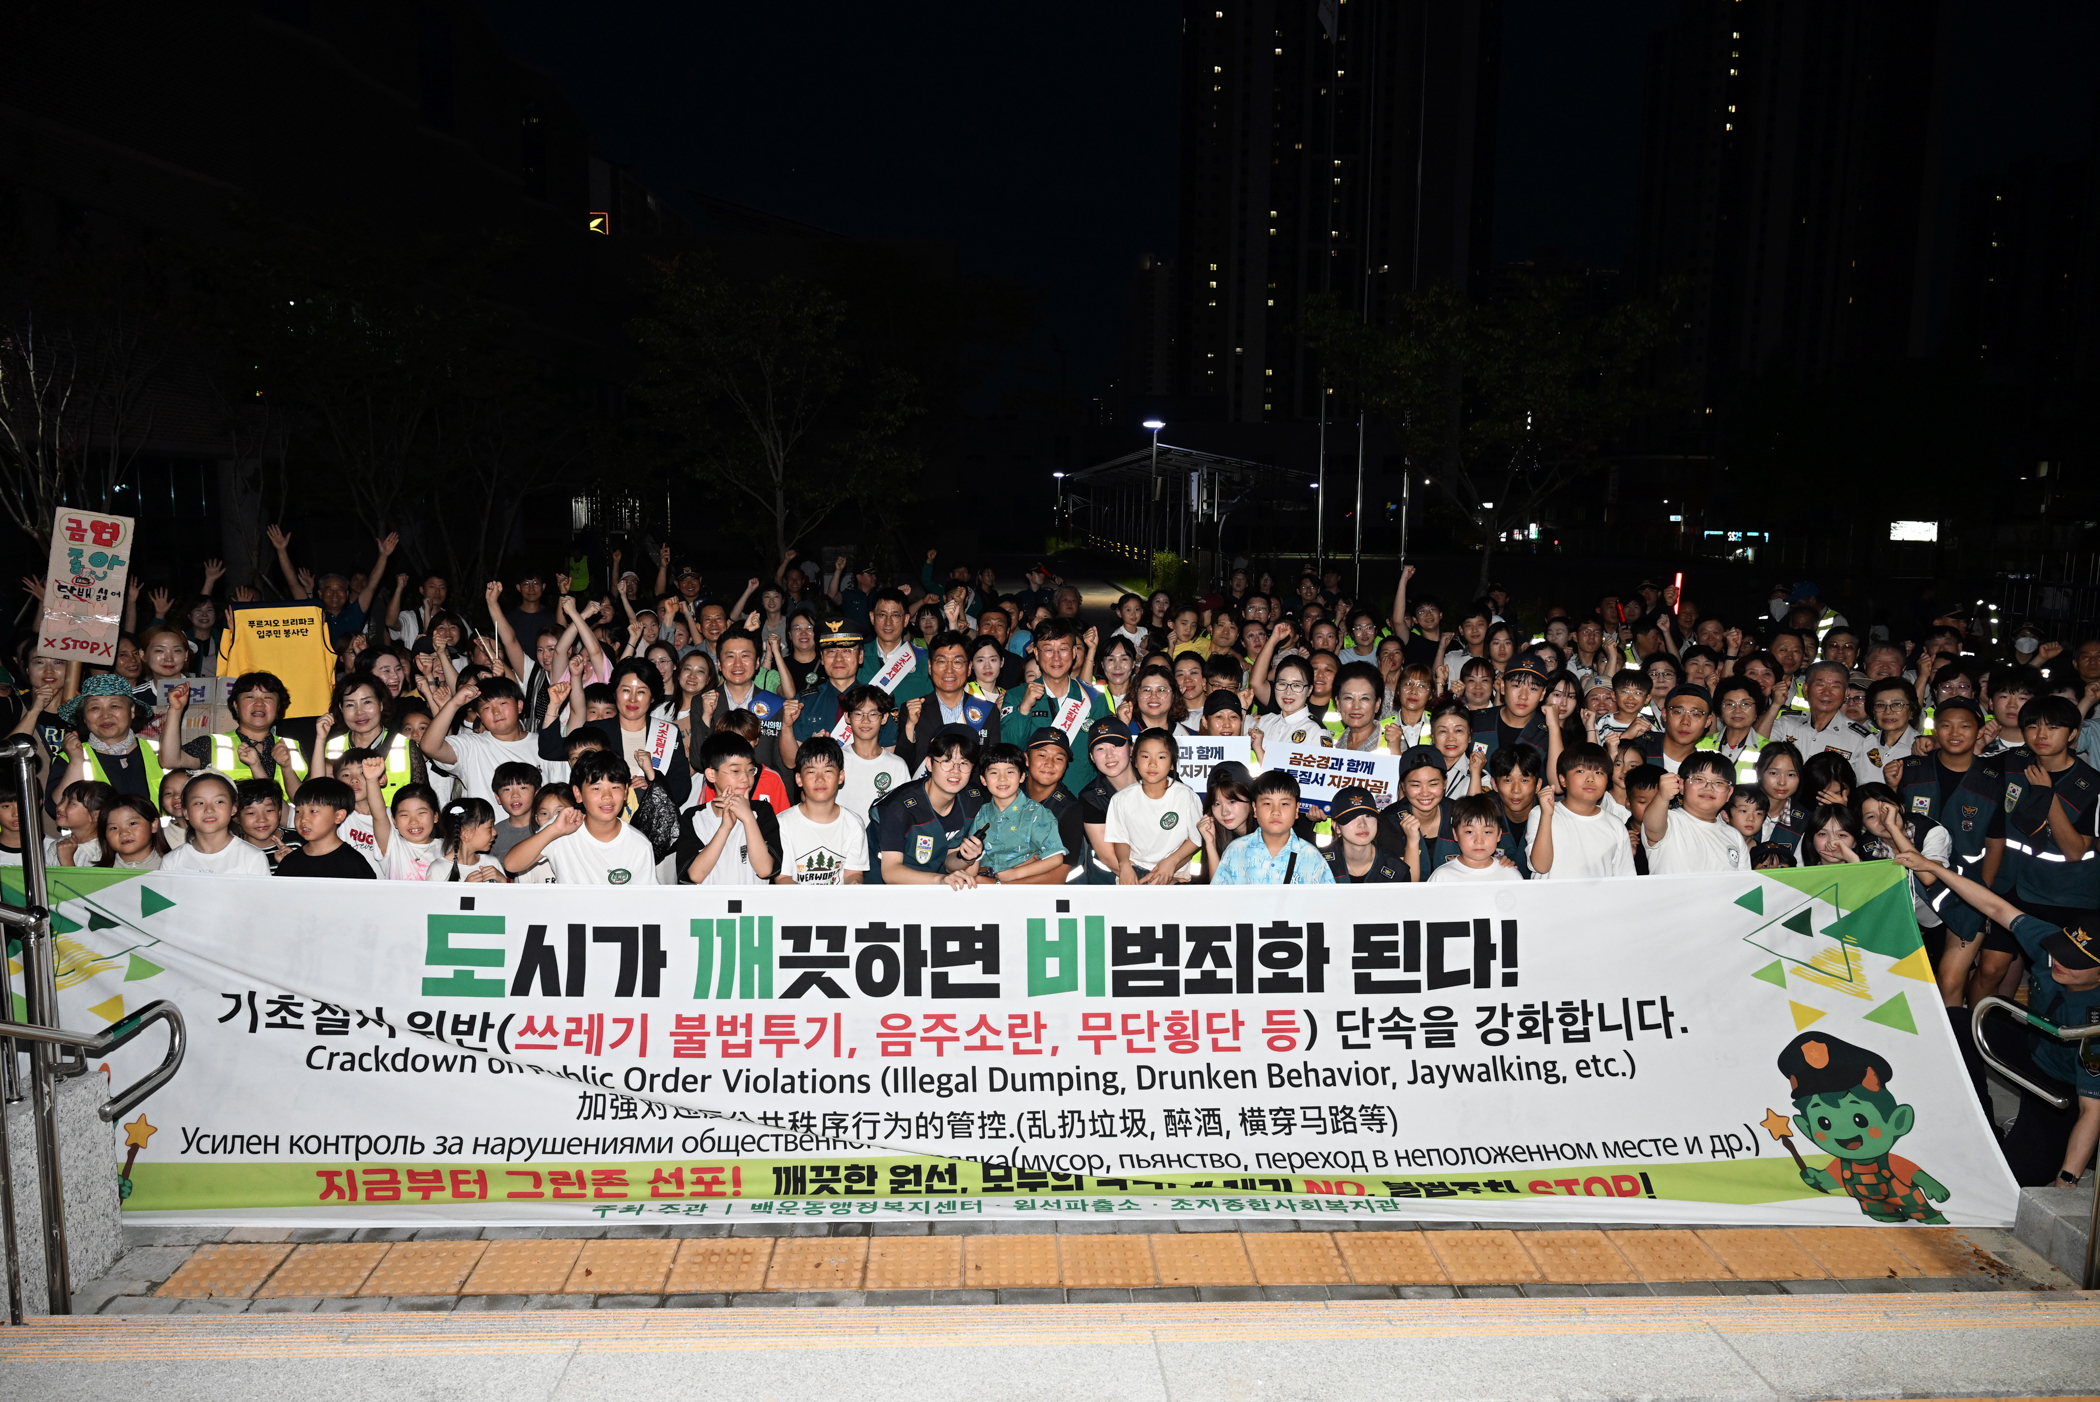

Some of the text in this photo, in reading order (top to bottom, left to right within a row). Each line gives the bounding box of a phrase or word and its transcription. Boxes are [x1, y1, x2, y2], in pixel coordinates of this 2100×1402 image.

[65, 517, 120, 547] 금연
[67, 547, 126, 575] 좋아
[248, 617, 315, 628] 푸르지오 브리파크
[256, 628, 309, 639] 입주민 봉사단
[59, 637, 100, 654] STOP
[1196, 745, 1225, 761] 함께
[1289, 752, 1375, 775] 곰순경과 함께
[422, 897, 1519, 999] 도시가 깨끗하면 비범죄화 된다!
[669, 1012, 858, 1059] 불법투기,
[875, 1012, 1059, 1058] 음주소란,
[1077, 1008, 1245, 1053] 무단횡단
[1261, 1008, 1318, 1052] 등)
[1336, 1005, 1459, 1050] 단속을
[1474, 995, 1689, 1046] 강화합니다.
[306, 1045, 477, 1074] Crackdown
[488, 1057, 524, 1074] on
[623, 1066, 712, 1094] Order
[722, 1066, 871, 1095] Violations
[881, 1064, 977, 1098] (Illegal
[993, 1066, 1126, 1098] Dumping,
[1136, 1062, 1259, 1092] Drunken
[1267, 1057, 1398, 1091] Behavior,
[1406, 1053, 1569, 1087] Jaywalking,
[1574, 1049, 1637, 1081] etc.)
[1164, 1108, 1231, 1139] 醉酒,
[1239, 1105, 1398, 1138] 横穿马路等)
[180, 1126, 280, 1156] Усилен
[289, 1133, 426, 1161] контроль
[432, 1135, 464, 1155] за
[472, 1135, 674, 1162] нарушениями
[1119, 1152, 1249, 1172] пьянство,
[1256, 1150, 1369, 1174] переход
[1373, 1150, 1389, 1168] в
[1395, 1143, 1597, 1168] неположенном
[1602, 1136, 1680, 1159] месте
[1684, 1136, 1704, 1155] и
[1709, 1124, 1762, 1160] др.)
[315, 1168, 488, 1201] 지금부터
[506, 1168, 630, 1199] 그린존
[647, 1165, 742, 1198] 선포!
[772, 1164, 878, 1196] 깨끗한
[889, 1162, 968, 1195] 원선,
[750, 1200, 982, 1216] 백운동행정복지센터
[1013, 1198, 1142, 1212] 원선파출소
[1170, 1198, 1401, 1213] 초지종합사회복지관
